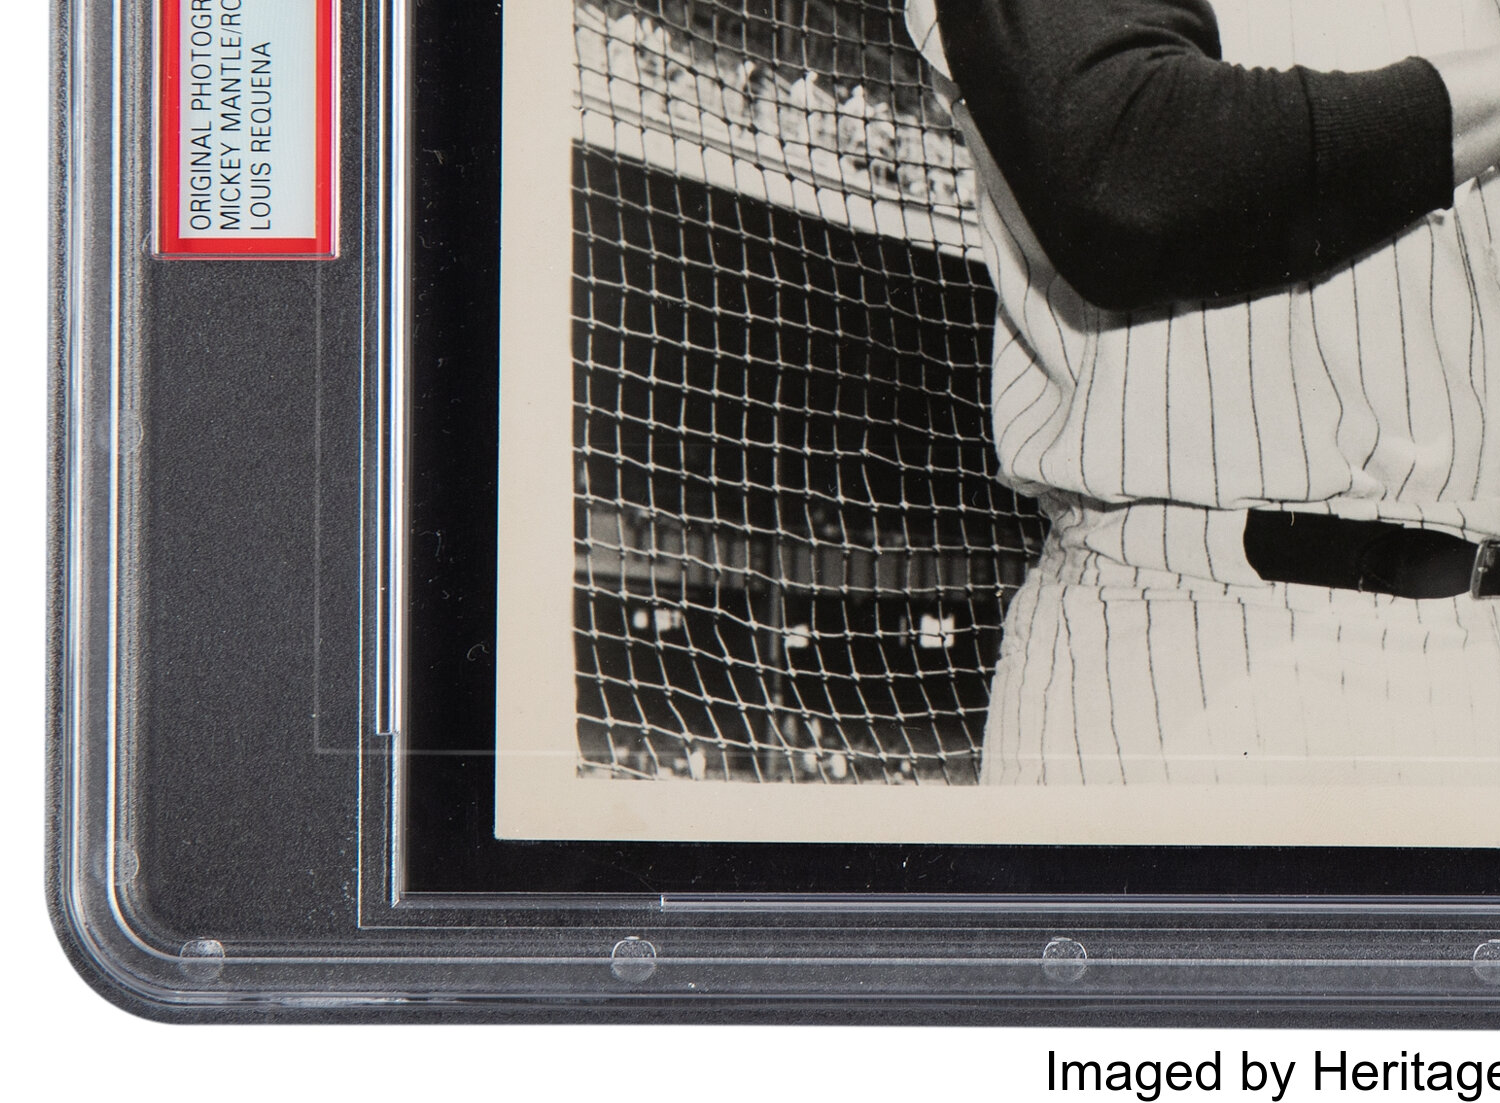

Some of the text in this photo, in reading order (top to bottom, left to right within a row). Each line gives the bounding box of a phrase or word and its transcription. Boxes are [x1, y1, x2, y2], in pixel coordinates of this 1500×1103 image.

[189, 121, 212, 231] ORIGINAL
[219, 141, 242, 230] MICKEY
[248, 40, 273, 230] LOUIS REQUENA
